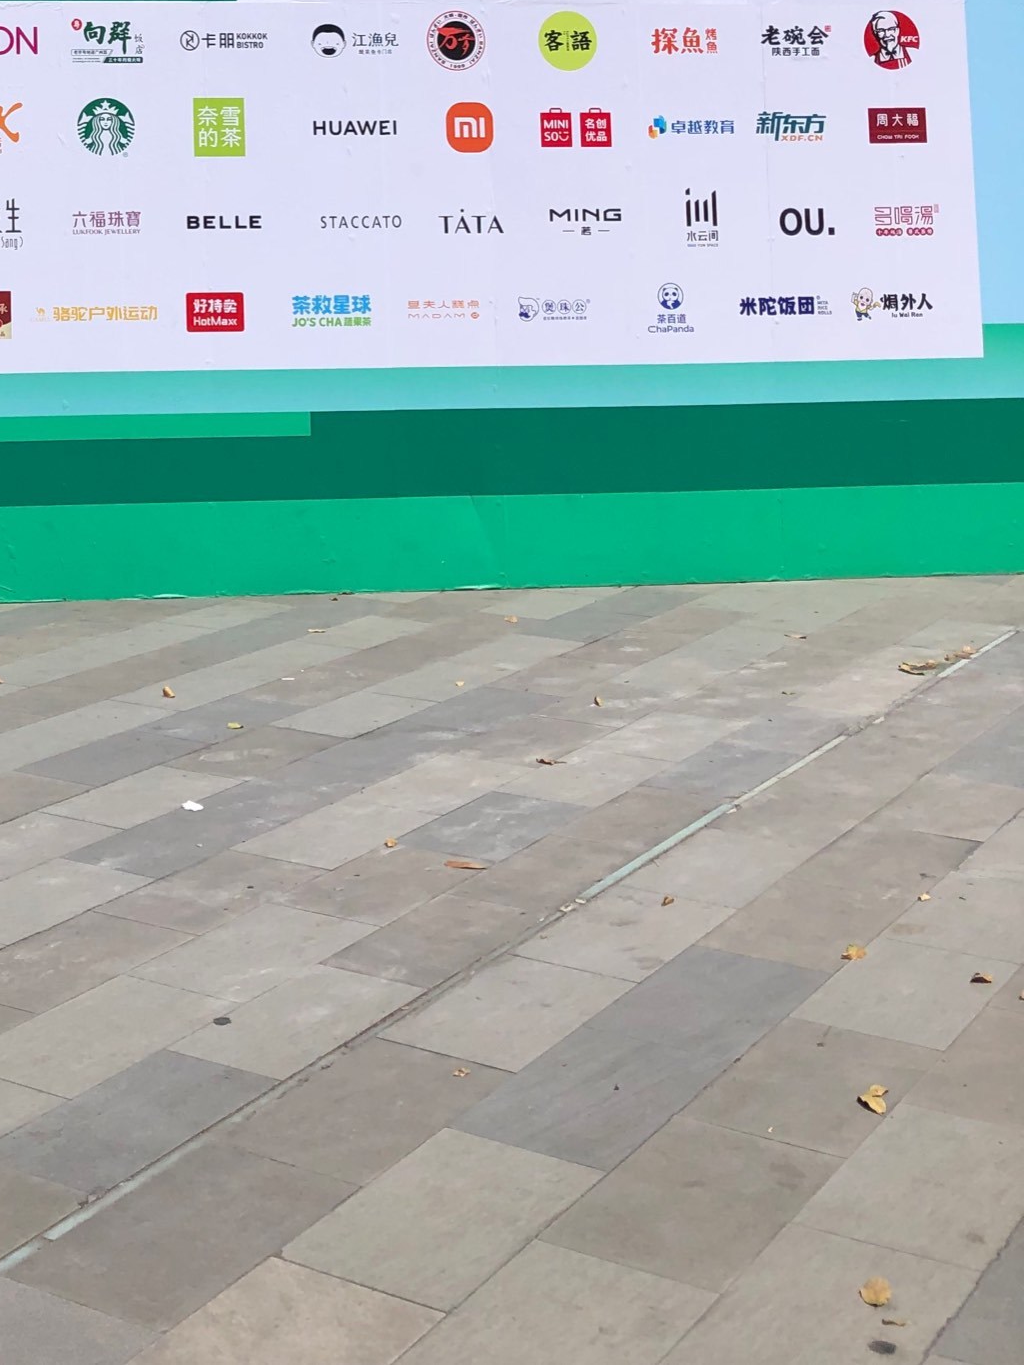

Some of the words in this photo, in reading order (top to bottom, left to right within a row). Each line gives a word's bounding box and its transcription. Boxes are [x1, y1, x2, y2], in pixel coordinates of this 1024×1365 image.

[651, 26, 704, 54] 探魚
[761, 25, 829, 45] 老碗会
[899, 35, 919, 43] KFC
[236, 41, 264, 49] BISTRO
[772, 47, 820, 56] 陕西手工面
[197, 106, 241, 126] 奈雪
[876, 113, 919, 127] 周大福
[313, 120, 397, 135] HUAWEI
[544, 119, 569, 129] MINI
[585, 118, 607, 129] 名创
[671, 120, 735, 135] 卓越教育
[756, 111, 827, 141] 新东方
[198, 128, 242, 148] 的茶
[585, 131, 608, 142] 优品
[320, 215, 402, 229] STACCATO
[549, 208, 621, 222] MING
[186, 216, 261, 229] BELLE
[687, 230, 719, 241] 水云间
[193, 299, 237, 313] 好特卖
[292, 294, 372, 315] 茶救星球
[53, 306, 158, 322] 骆驼户外运动
[657, 314, 687, 324] 茶百道
[292, 317, 316, 327] JO'S
[319, 317, 342, 327] CHA
[647, 325, 695, 333] ChaPanda
